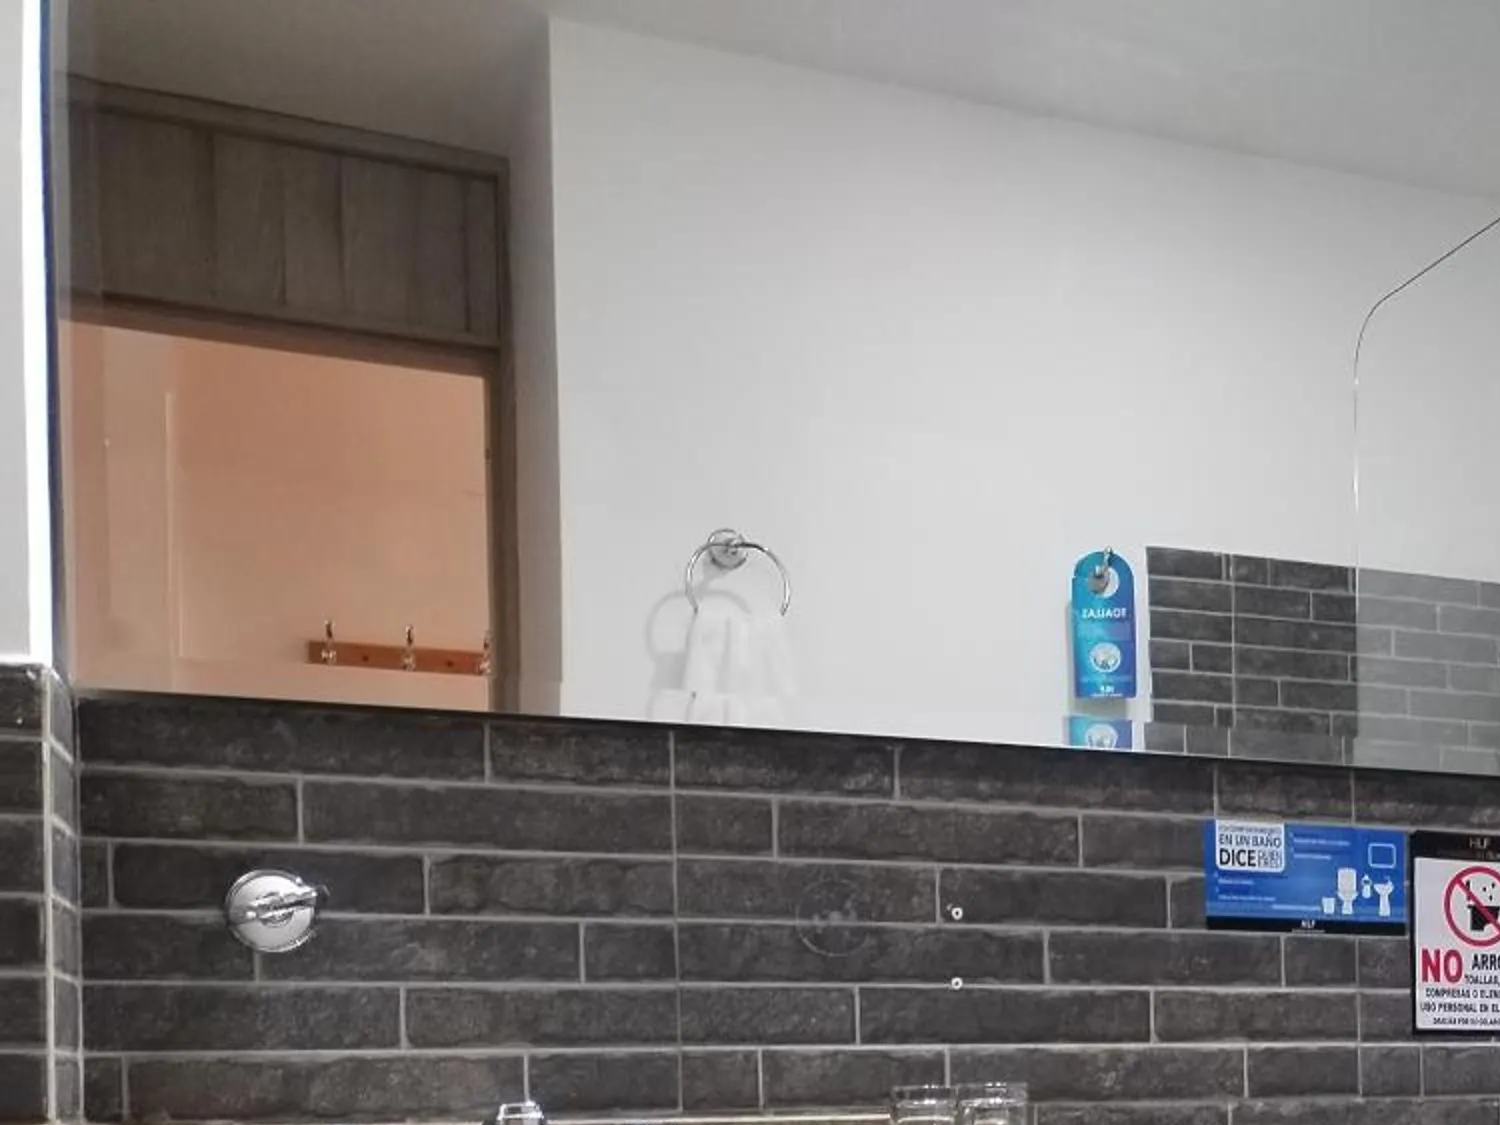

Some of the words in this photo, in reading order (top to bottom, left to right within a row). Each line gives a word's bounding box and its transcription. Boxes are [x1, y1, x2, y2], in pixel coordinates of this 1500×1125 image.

[1219, 833, 1232, 845] EN
[1235, 834, 1250, 847] UN
[1219, 847, 1257, 867] DICE
[1421, 948, 1463, 983] NO
[1464, 974, 1500, 986] TOALLAS,
[1472, 989, 1479, 999] O
[1438, 1002, 1478, 1013] PERSONAL
[1480, 1003, 1489, 1013] EN
[1491, 1003, 1500, 1013] EL
